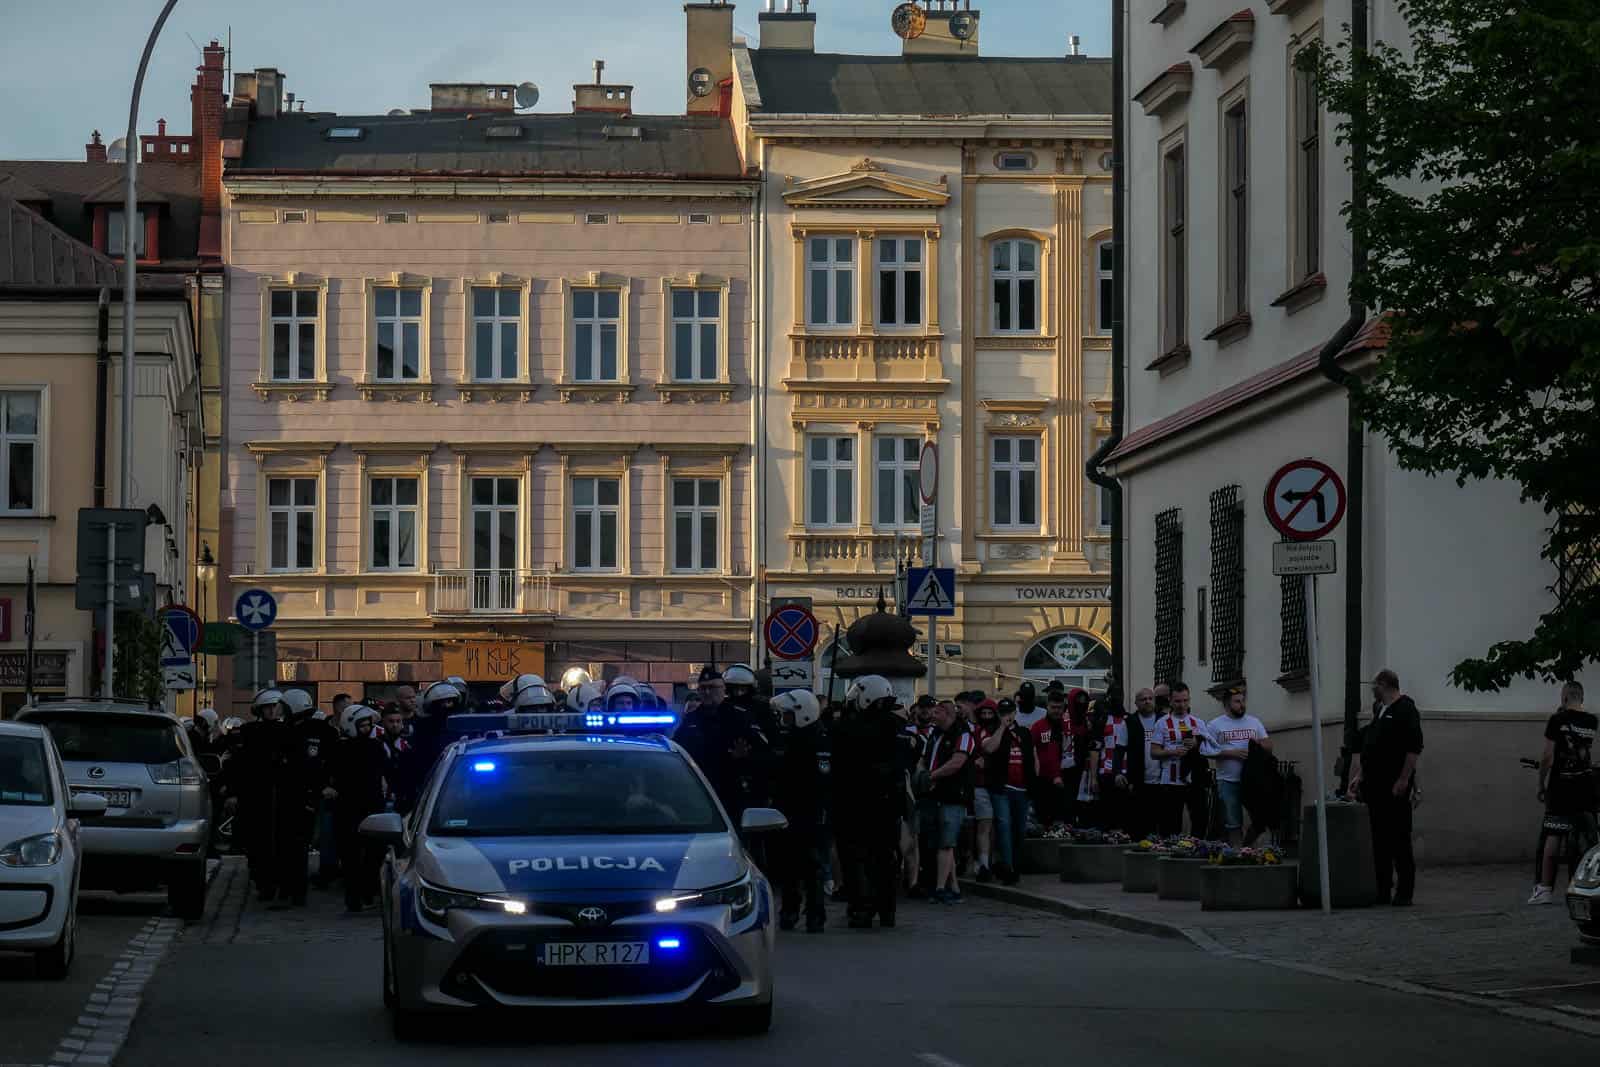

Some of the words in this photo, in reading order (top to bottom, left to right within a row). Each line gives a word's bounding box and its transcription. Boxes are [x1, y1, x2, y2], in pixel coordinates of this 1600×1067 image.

[1015, 587, 1110, 599] TOWARZYSTW
[508, 855, 667, 876] POLICJA
[549, 943, 586, 964] HPK
[595, 943, 644, 964] R127
